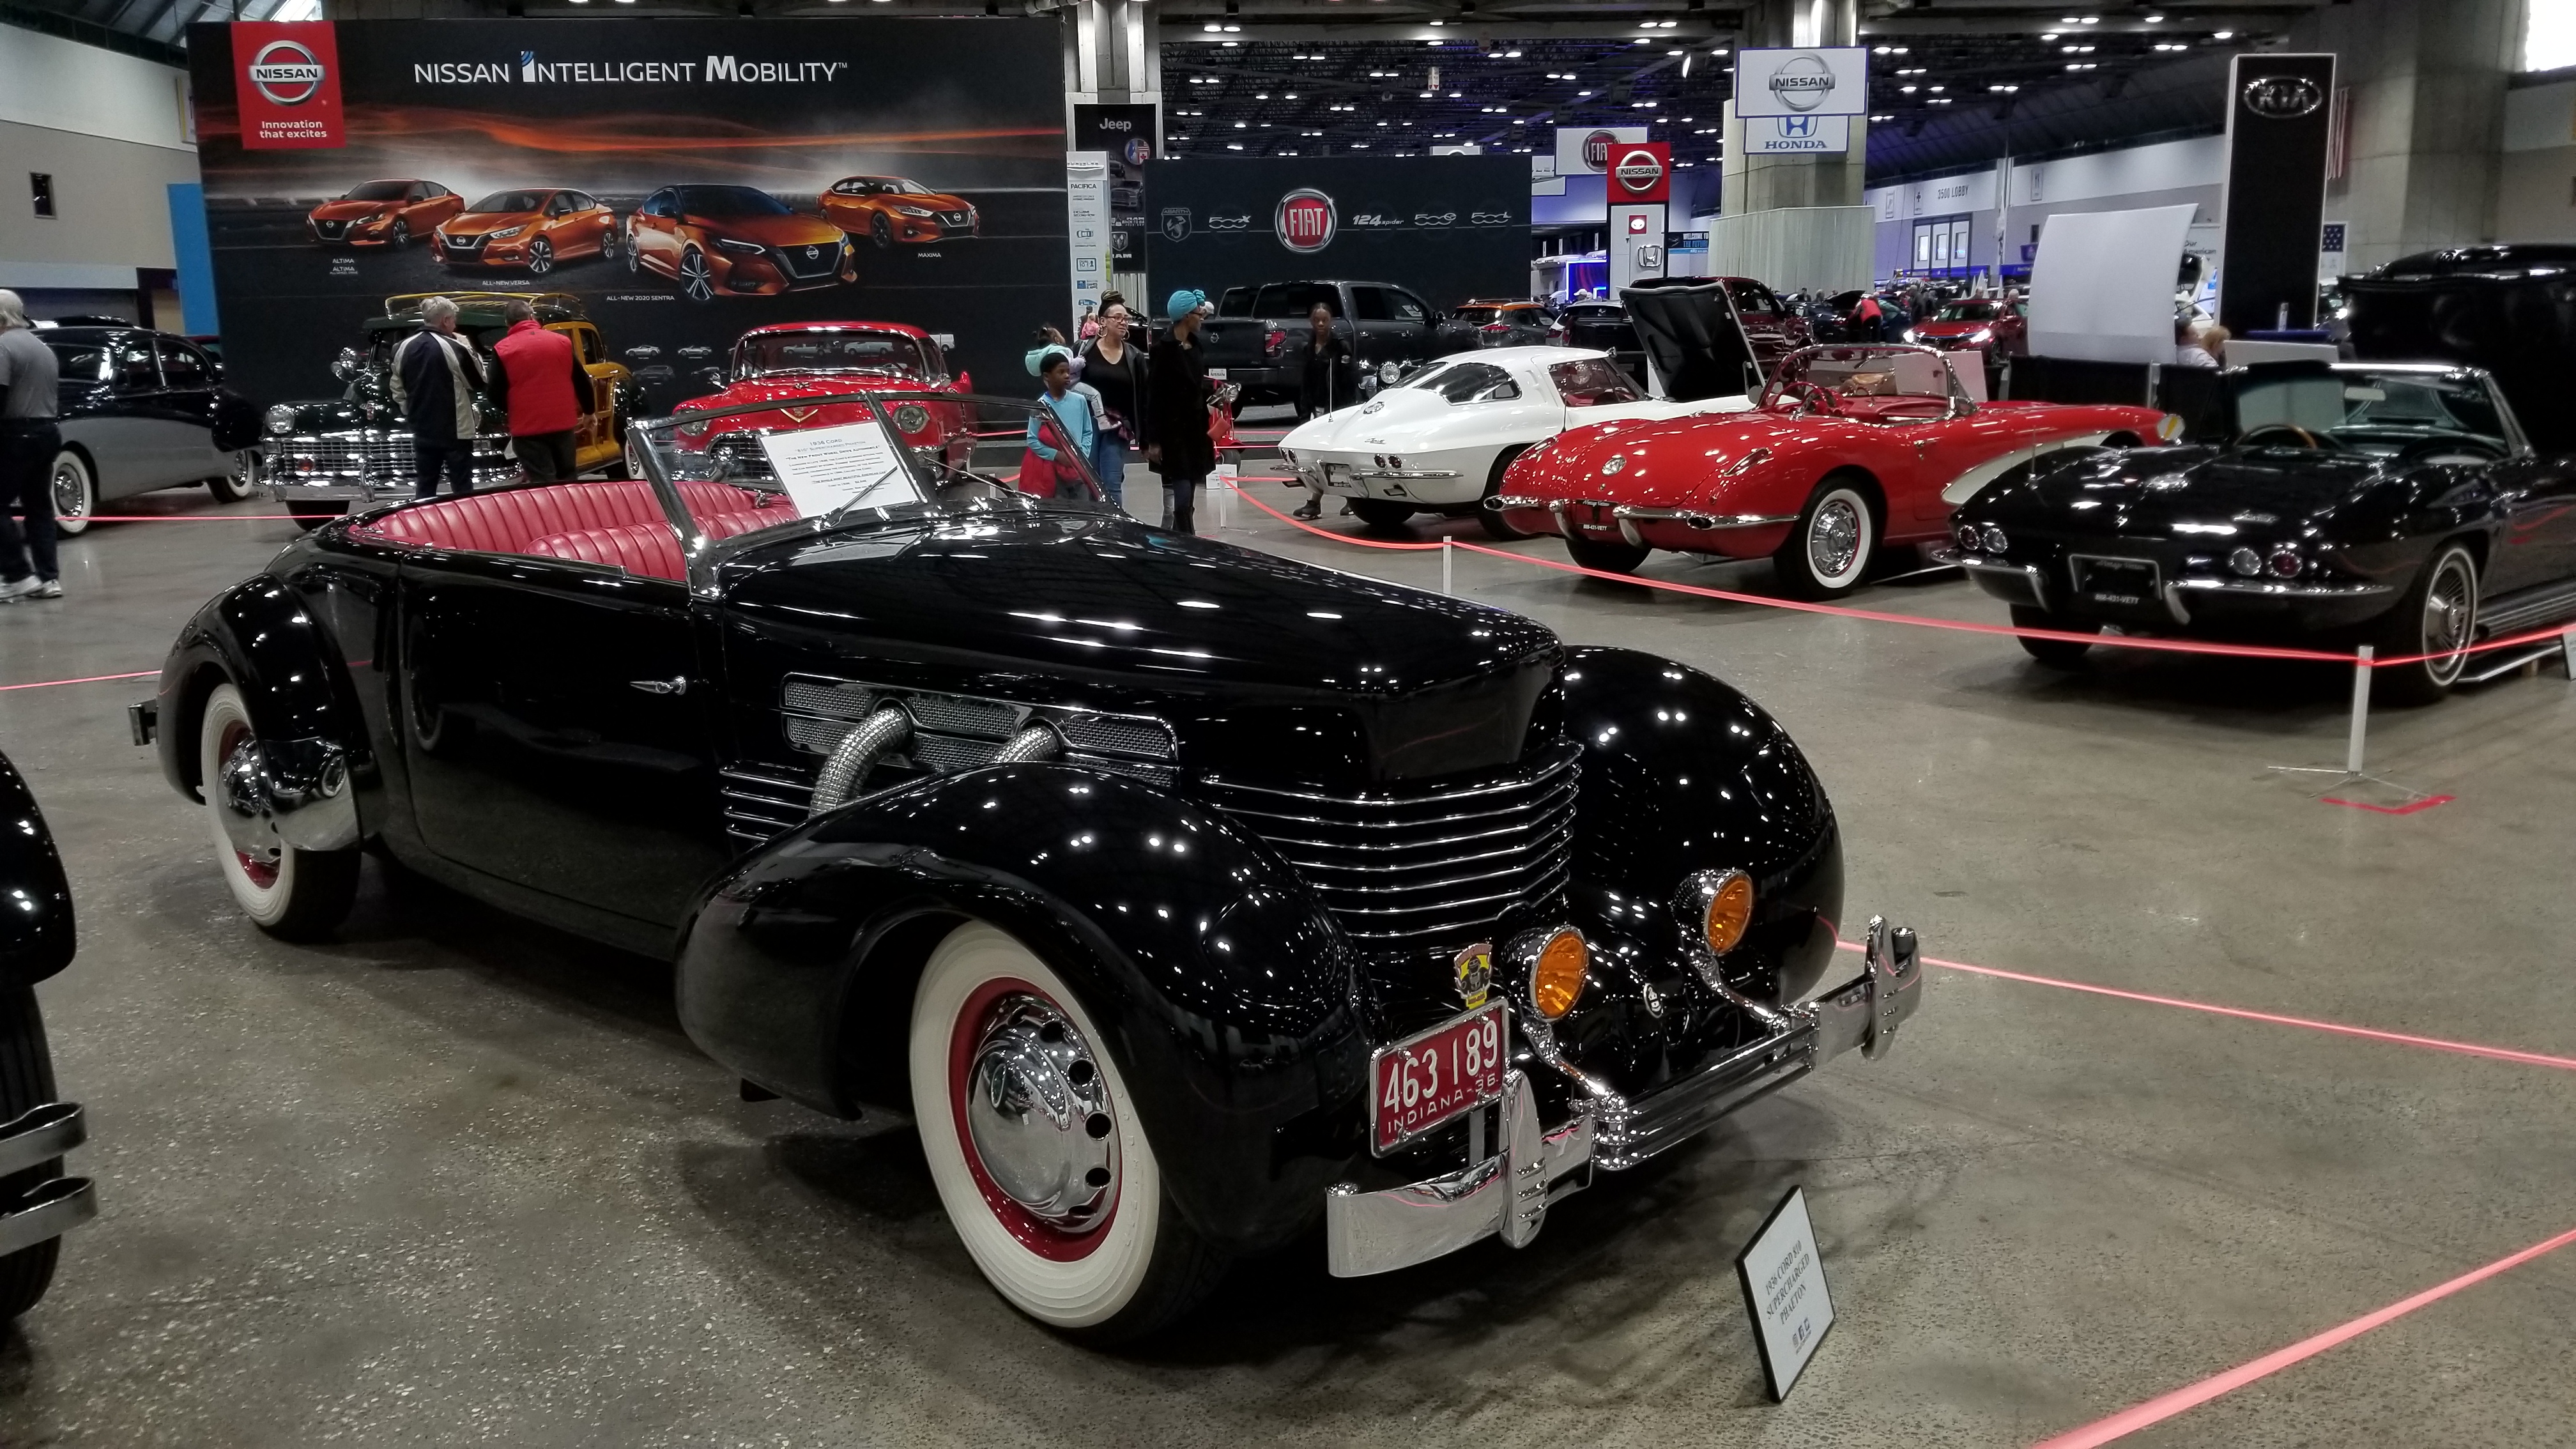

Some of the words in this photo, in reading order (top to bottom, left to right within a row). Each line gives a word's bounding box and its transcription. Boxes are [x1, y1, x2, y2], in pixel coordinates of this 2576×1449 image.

[256, 68, 318, 79] NISSAN
[414, 63, 510, 83] NISSAN
[521, 50, 696, 82] INTELLIGENT
[1775, 77, 1829, 88] NISSAN
[2257, 85, 2309, 109] KIA
[262, 119, 323, 129] Innovation
[1099, 118, 1131, 132] Jeep
[259, 130, 284, 139] that
[287, 129, 327, 138] excites
[1591, 142, 1611, 161] FIA
[1764, 140, 1827, 150] HONDA
[1621, 167, 1659, 176] NISSAN
[1951, 185, 1969, 197] LOBBY
[1289, 208, 1323, 236] FIAT
[1353, 214, 1381, 226] 124
[1384, 1048, 1438, 1114] 463
[1453, 1020, 1498, 1085] 189
[1777, 1252, 1793, 1279] CORD
[1767, 1254, 1809, 1319] SUPERCHARGED
[1780, 1282, 1807, 1324] PHAETON
